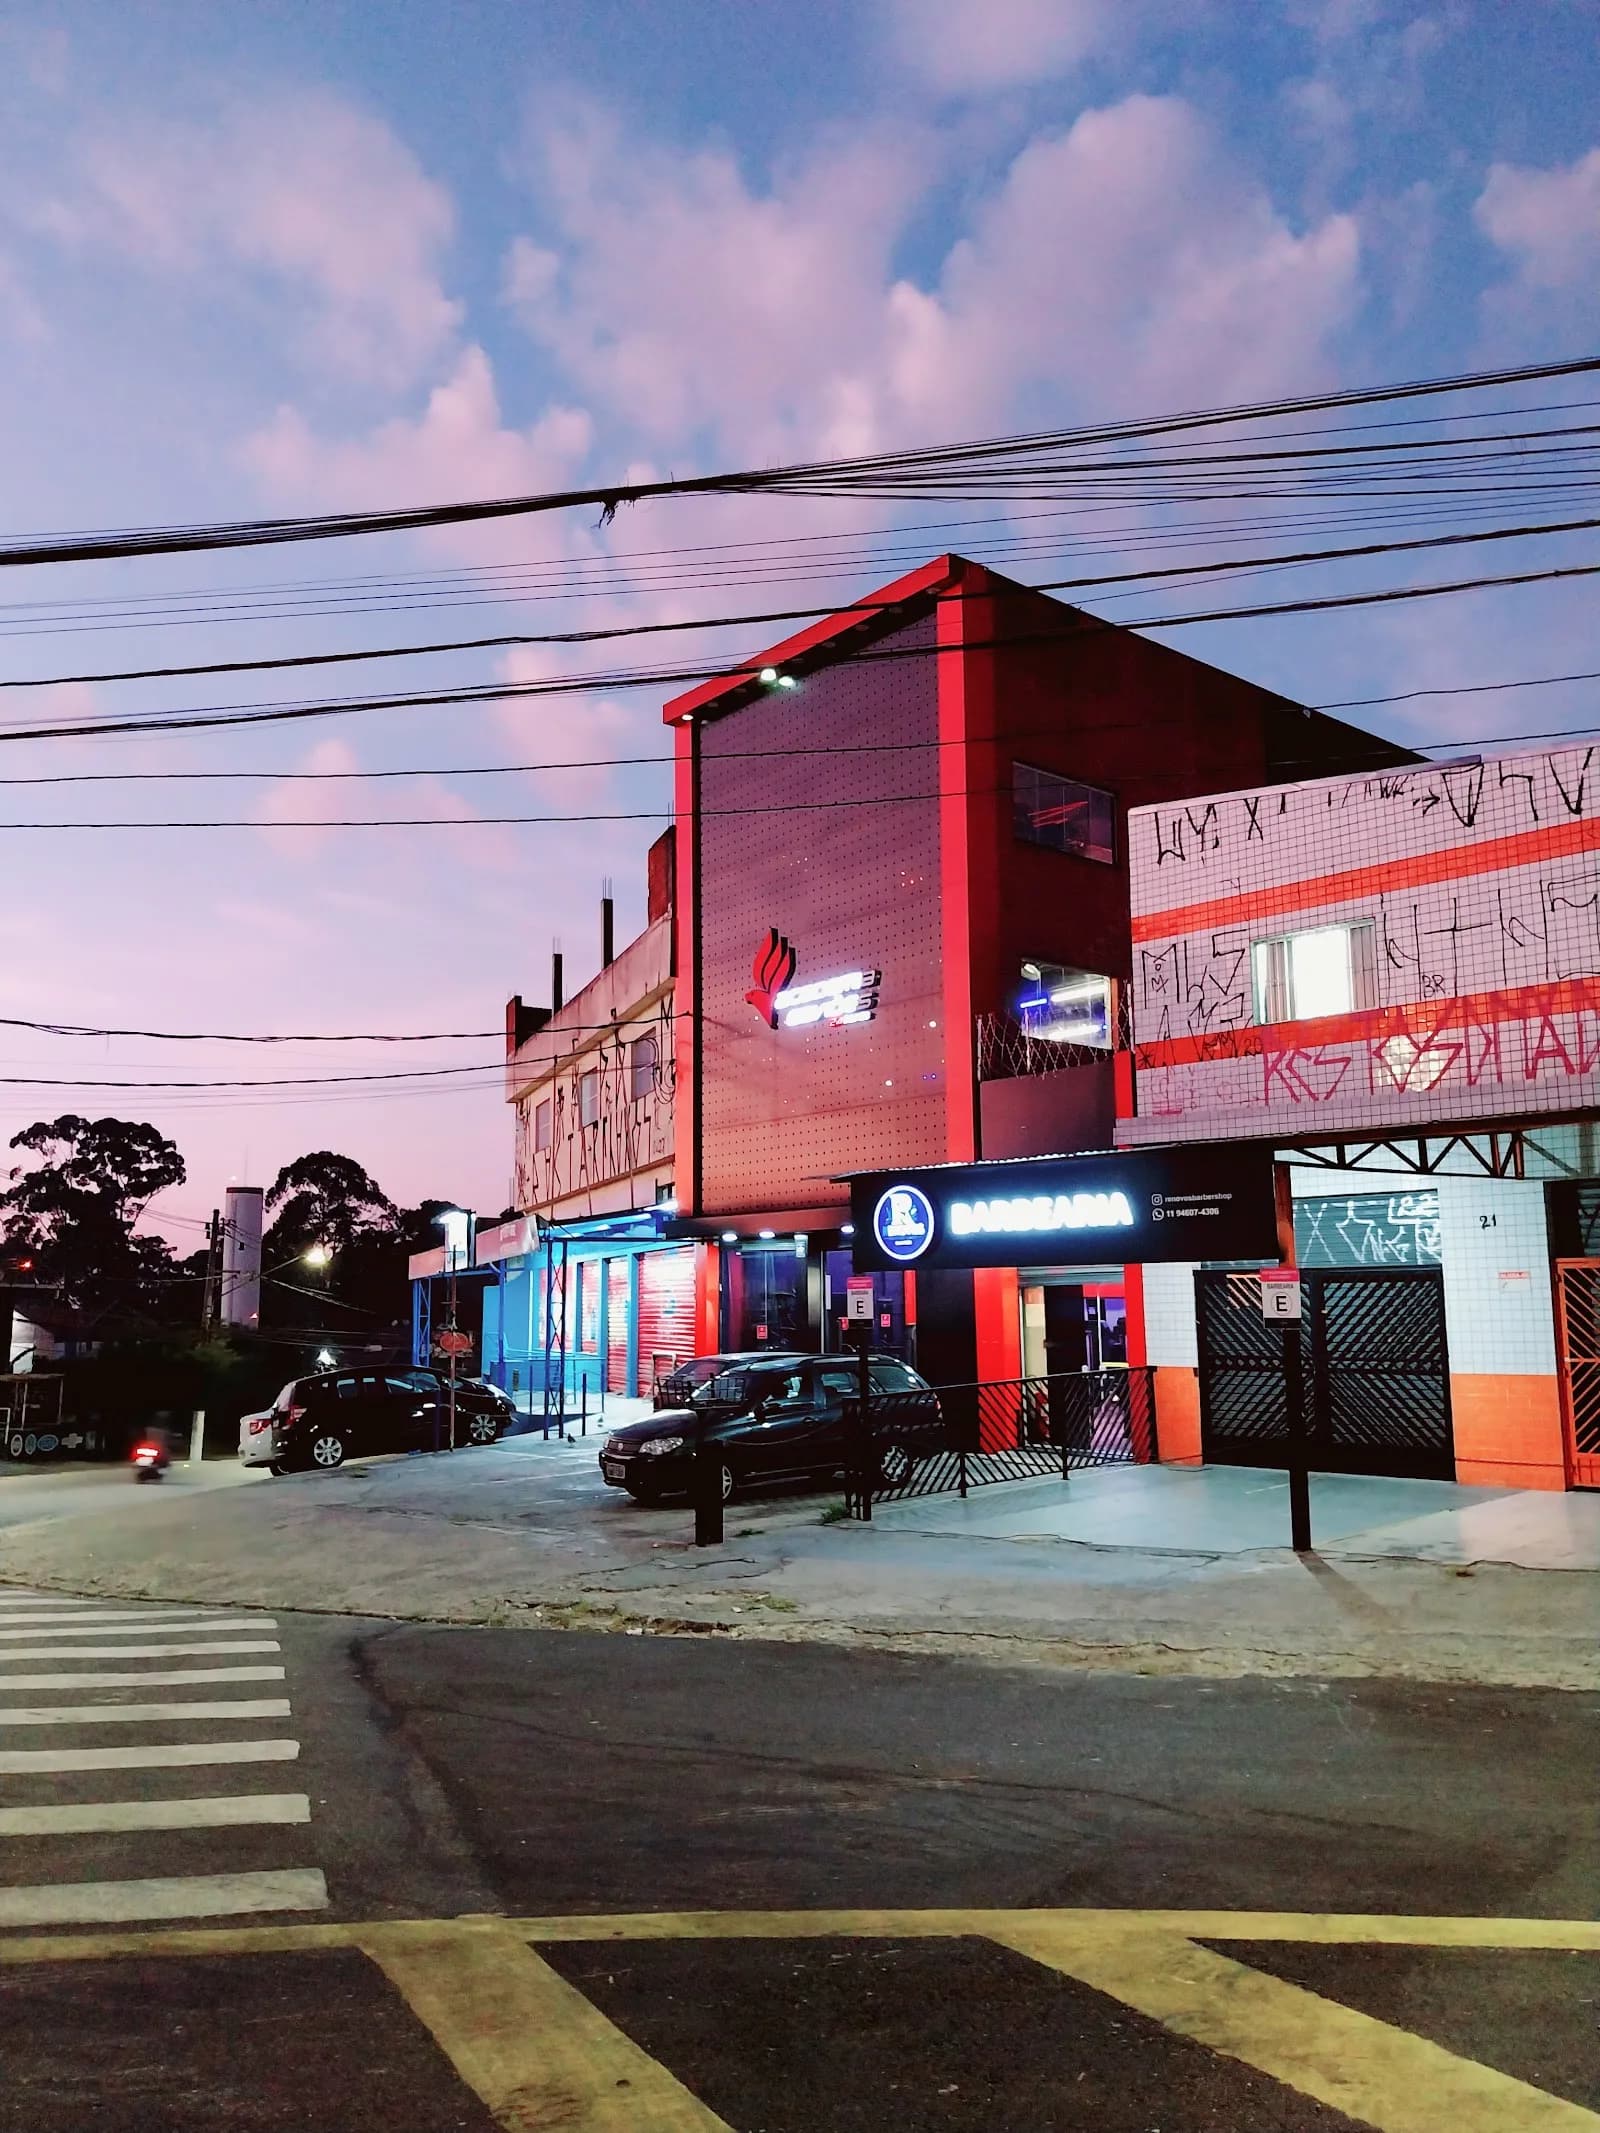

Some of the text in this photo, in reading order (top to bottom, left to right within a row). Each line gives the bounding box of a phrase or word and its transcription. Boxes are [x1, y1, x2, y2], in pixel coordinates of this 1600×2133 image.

[951, 1192, 1134, 1235] BARBEARIA
[1166, 1209, 1175, 1218] 11
[1479, 1214, 1497, 1230] 21
[856, 1300, 865, 1314] E
[1276, 1295, 1288, 1312] E
